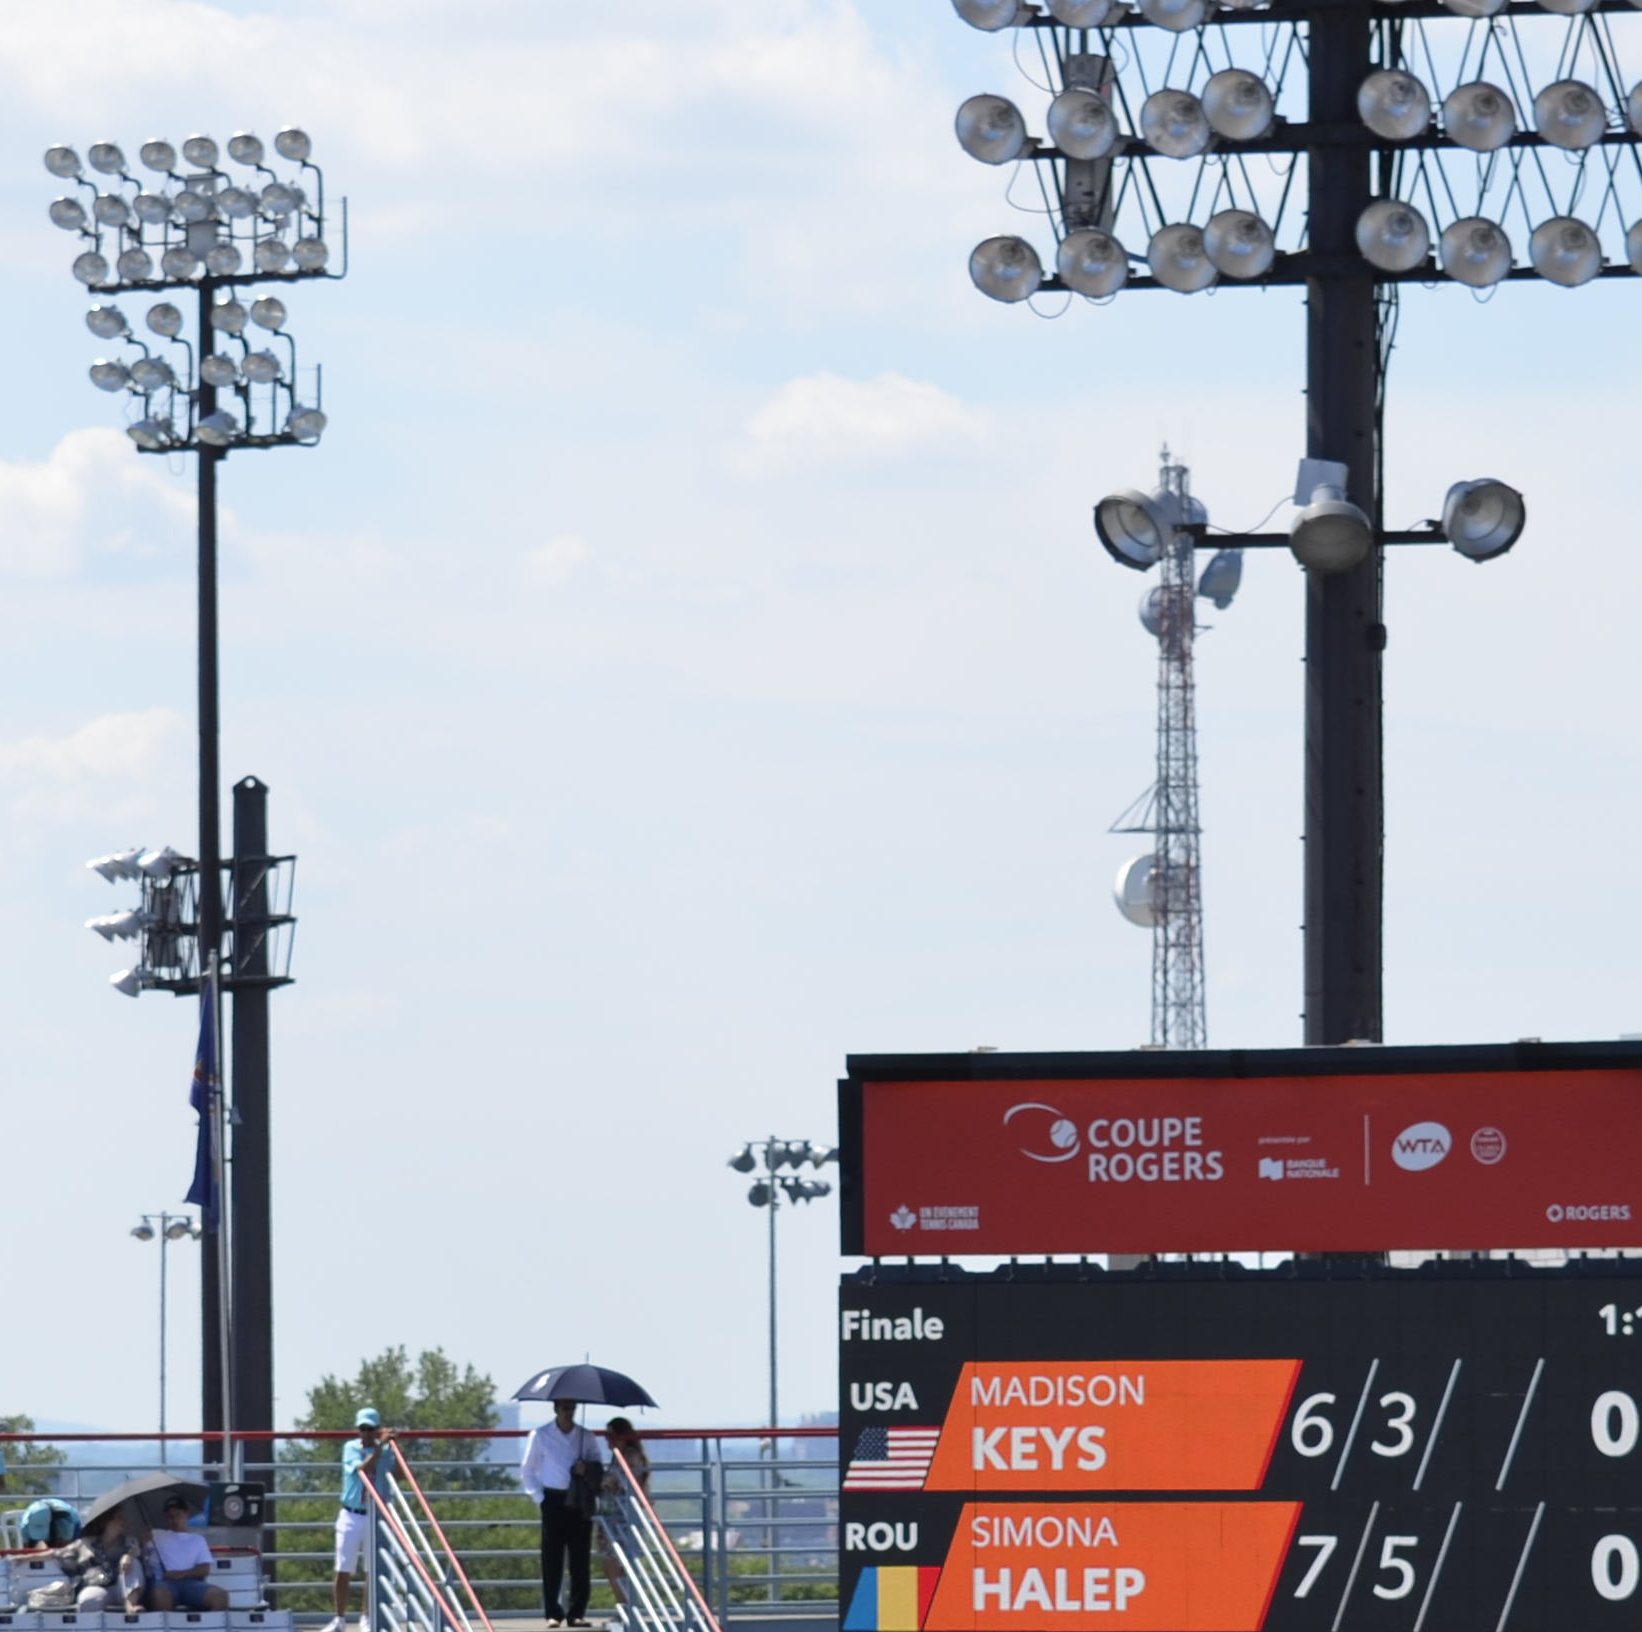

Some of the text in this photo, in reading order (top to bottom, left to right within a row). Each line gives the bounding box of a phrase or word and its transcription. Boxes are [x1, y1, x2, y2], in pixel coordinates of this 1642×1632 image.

[1088, 1117, 1202, 1148] COUPE
[1397, 1138, 1446, 1154] WTA
[1089, 1151, 1223, 1181] ROGERS
[1286, 1158, 1326, 1168] BANQUE
[1565, 1204, 1632, 1221] ROGERS
[842, 1308, 943, 1340] Finale
[851, 1382, 918, 1410] USA
[972, 1375, 1144, 1406] MADISON
[1292, 1391, 1639, 1456] 6 3 0
[973, 1426, 1106, 1470] KEYS
[846, 1522, 917, 1550] ROU
[972, 1516, 1118, 1547] SIMONA
[1294, 1535, 1639, 1600] 7 5 0
[974, 1568, 1145, 1611] HALEP
